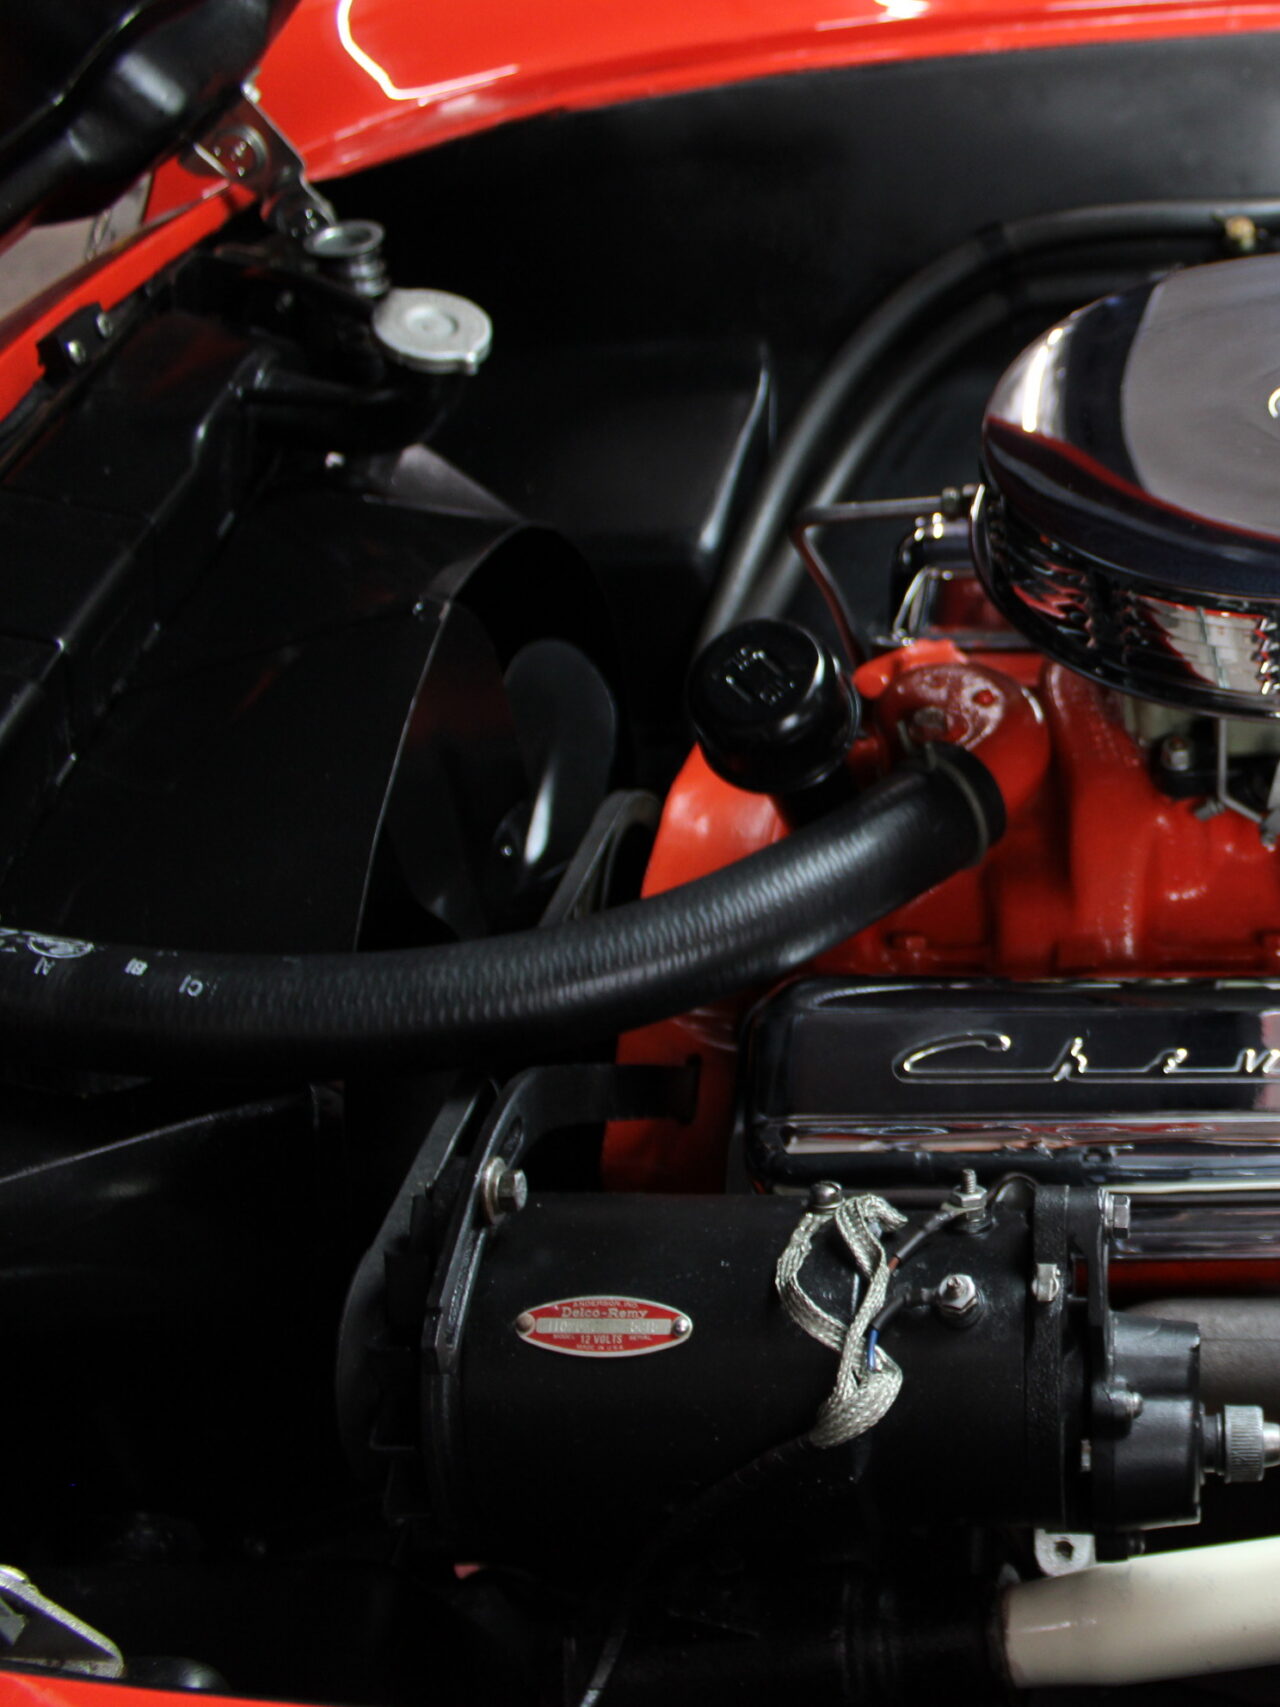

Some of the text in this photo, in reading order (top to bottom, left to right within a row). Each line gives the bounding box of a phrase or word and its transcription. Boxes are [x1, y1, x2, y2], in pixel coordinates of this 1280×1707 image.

[561, 1307, 649, 1319] Delco-Remy
[580, 1334, 623, 1344] 12 VOLTS
